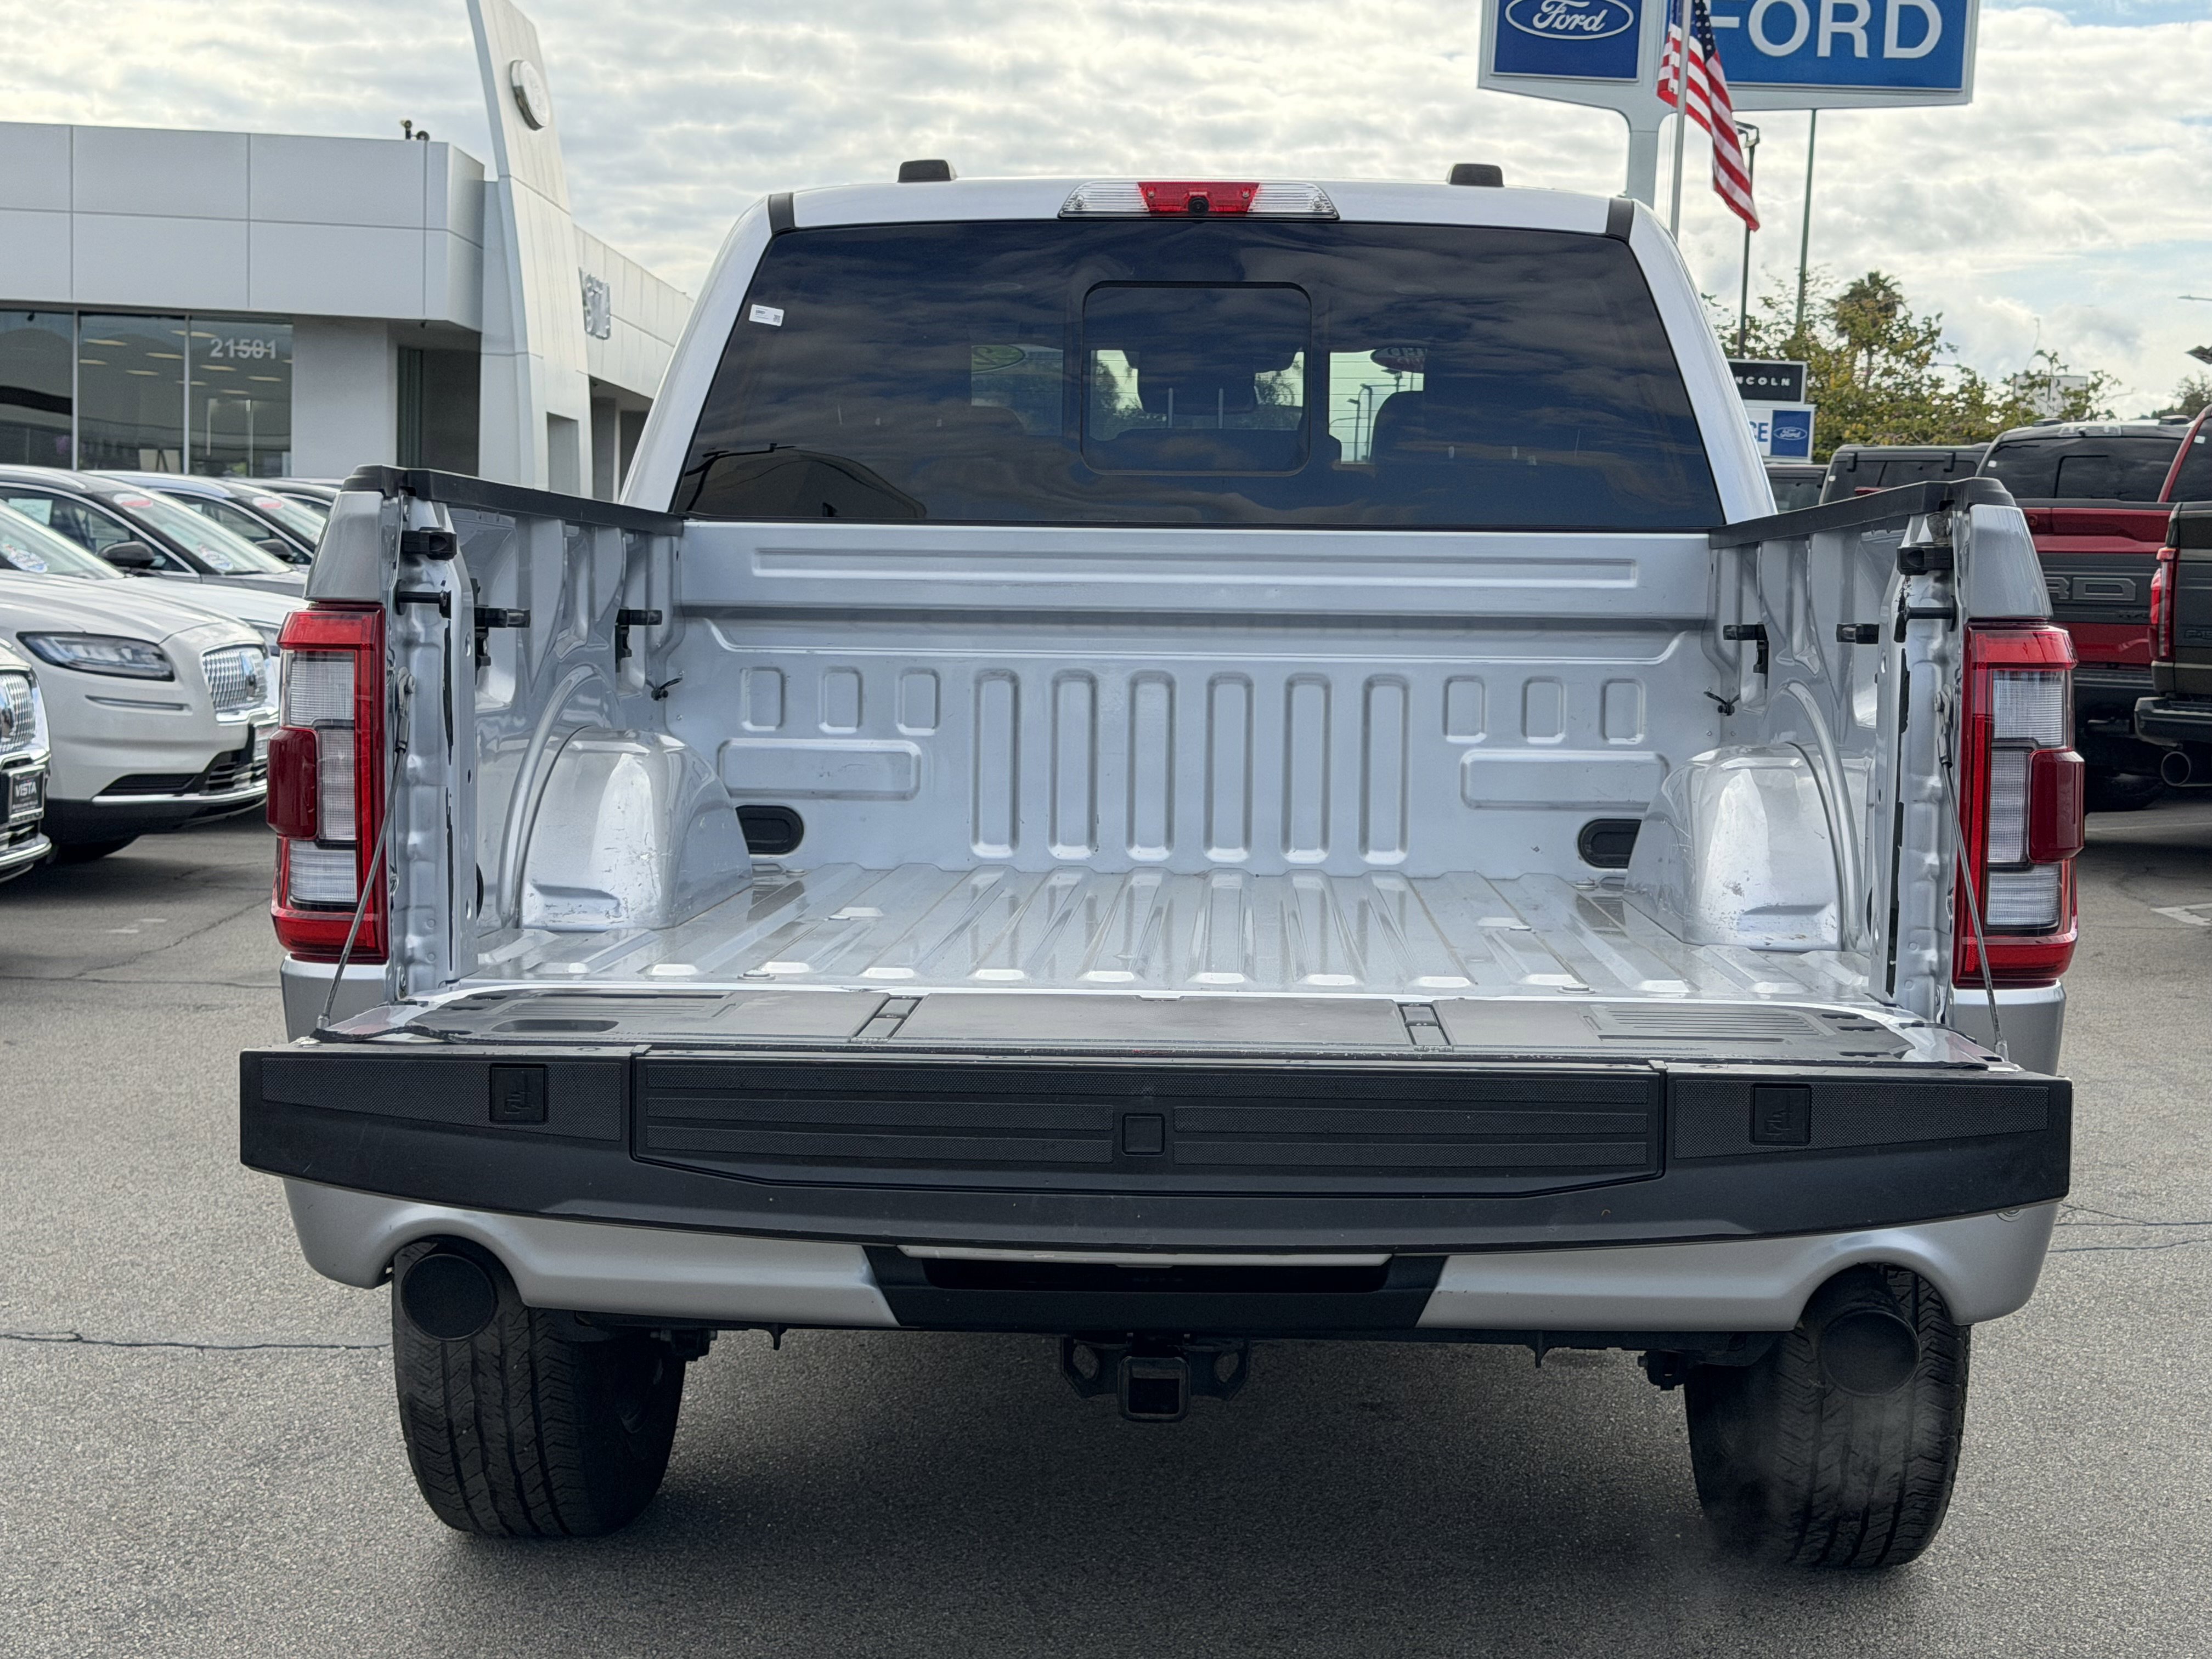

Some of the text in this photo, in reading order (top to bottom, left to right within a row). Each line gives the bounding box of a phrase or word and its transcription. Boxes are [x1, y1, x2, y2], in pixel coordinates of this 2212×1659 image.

[1532, 0, 1608, 31] Ford
[210, 338, 276, 359] 21581
[1735, 376, 1791, 386] NCOLN
